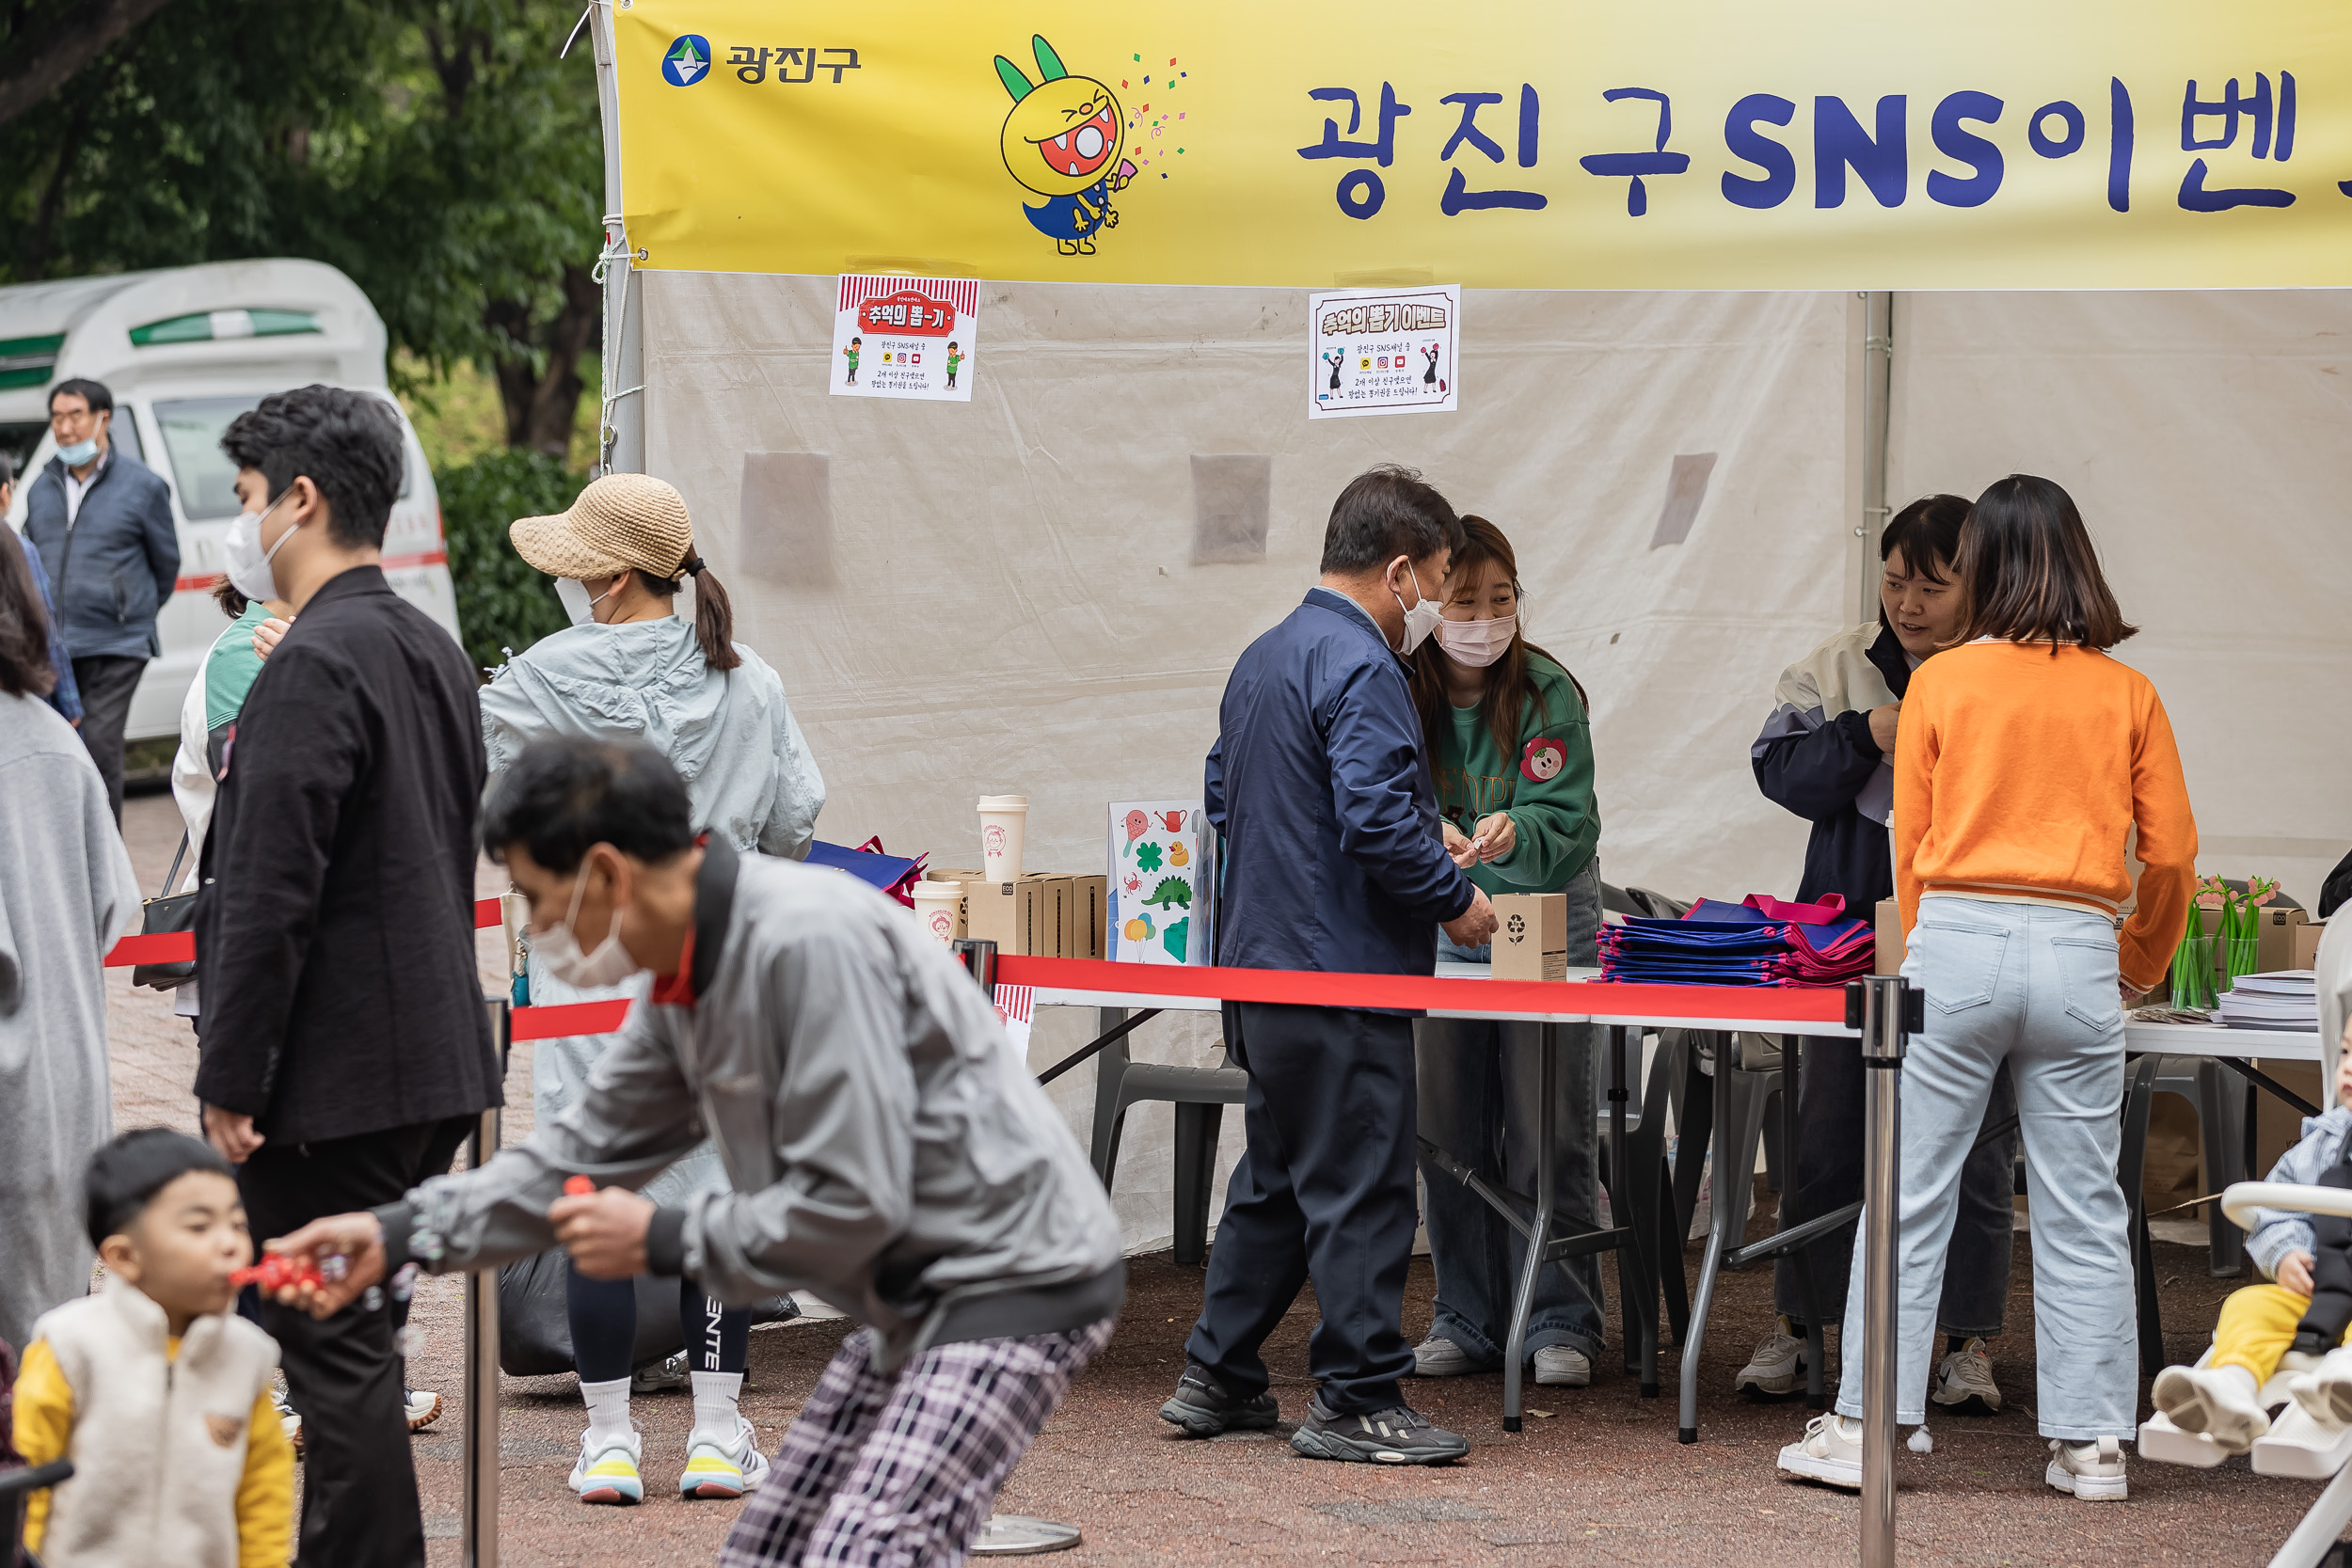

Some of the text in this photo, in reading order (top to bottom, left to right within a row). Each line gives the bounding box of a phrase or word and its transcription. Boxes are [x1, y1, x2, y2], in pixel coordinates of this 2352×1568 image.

[726, 46, 862, 85] 광진구
[868, 305, 908, 326] 추억의
[1322, 304, 1446, 336] 추억의 뽑기 이벤트
[882, 341, 896, 350] 광진구
[1357, 341, 1410, 354] 광진구 SNS채널 중
[1355, 377, 1366, 387] 2개
[1368, 376, 1380, 386] 이상
